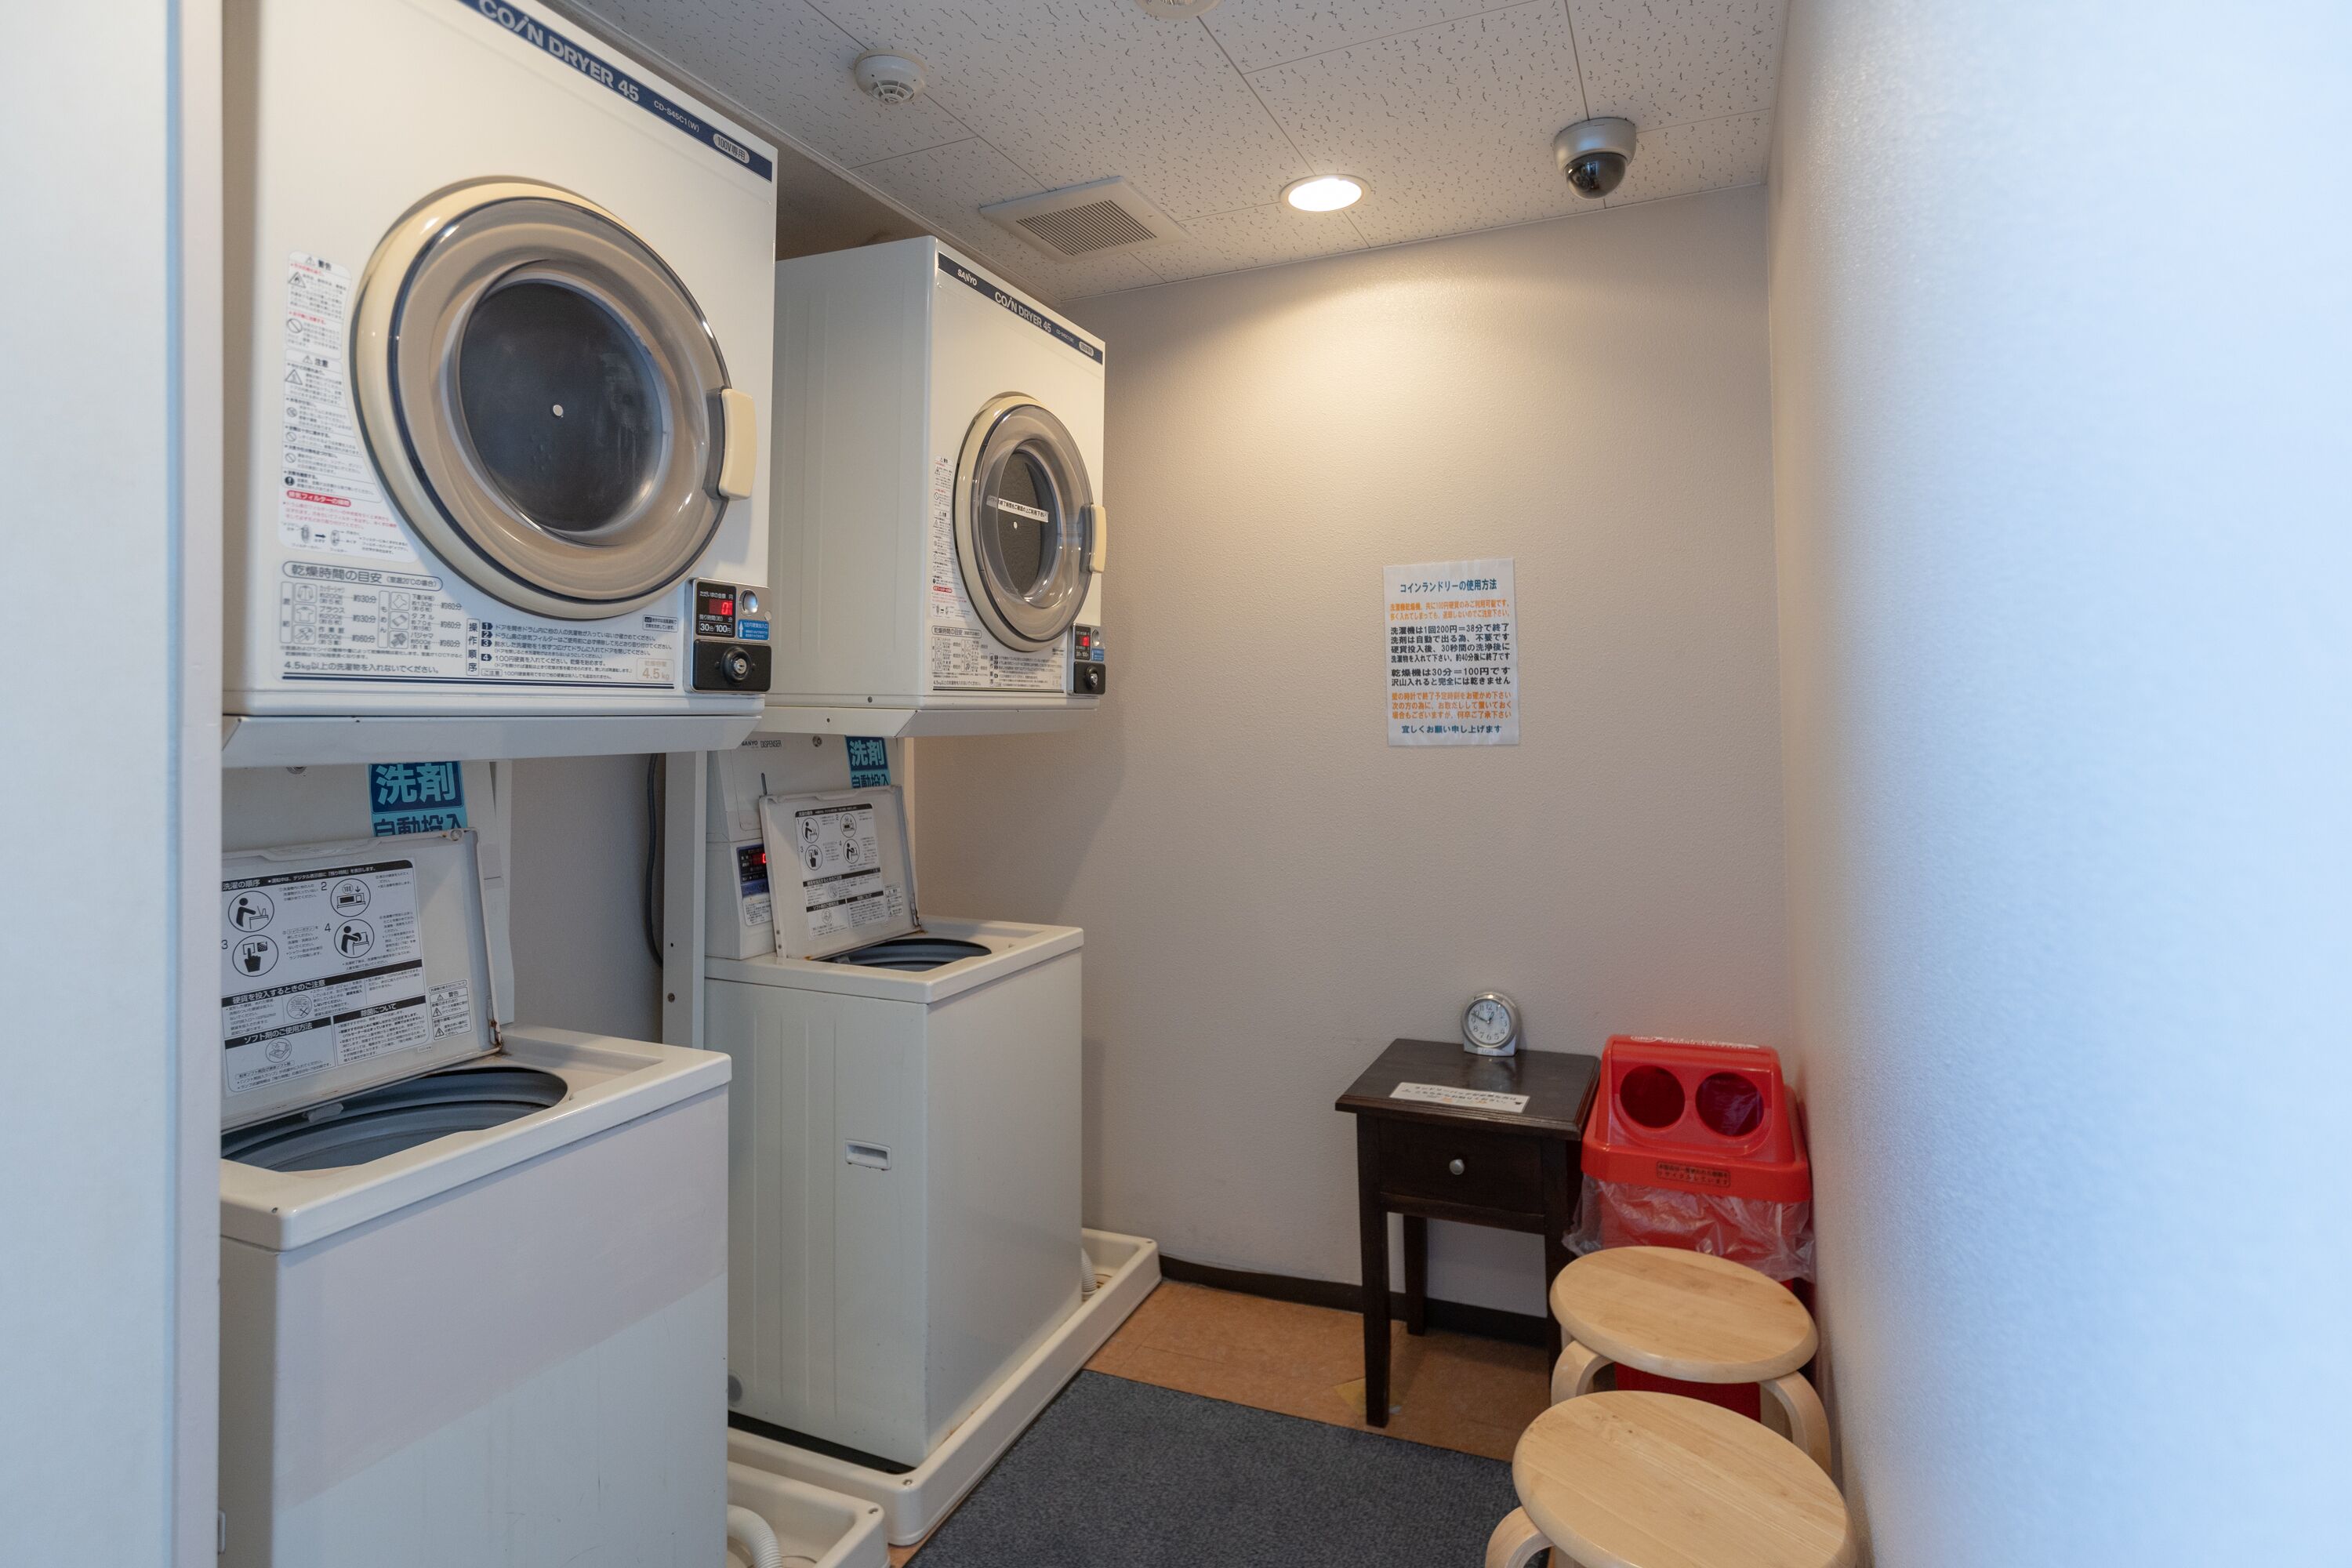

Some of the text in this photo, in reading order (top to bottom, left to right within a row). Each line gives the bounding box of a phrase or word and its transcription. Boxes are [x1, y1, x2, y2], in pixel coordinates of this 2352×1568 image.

[549, 36, 614, 89] DRYER
[618, 80, 640, 103] 45
[717, 136, 746, 162] 100V専用
[318, 260, 332, 271] 警告
[957, 269, 978, 286] SANYO
[1018, 306, 1042, 328] DRYER
[1043, 321, 1052, 333] 45
[314, 358, 329, 368] 注意
[292, 564, 382, 583] 乾燥時間の目安
[1399, 579, 1497, 593] コインランドリーの使用方法
[1390, 633, 1510, 644] 洗剤は自動で出る為、不要です
[468, 622, 477, 673] 操作順序
[1390, 643, 1510, 654] 硬貨投入後、30秒間の洗浄後に
[1390, 652, 1511, 663] 洗濯物を入れて下さい。約40分後に終了です
[1392, 677, 1511, 687] 沢山入れると完全には乾きません
[1401, 724, 1502, 734] 宜しくお願い申し上げます
[850, 739, 885, 767] 洗剤
[376, 763, 457, 806] 洗剤
[852, 775, 889, 788] 自動投入
[373, 812, 463, 837] 自動投入
[223, 879, 260, 891] 洗濯の順序
[321, 882, 327, 891] 2
[324, 923, 332, 933] 4
[221, 939, 229, 950] 3
[232, 979, 326, 1004] 硬貨を投入するときのご注意
[244, 1022, 313, 1044] ソフト剤のご使用方法
